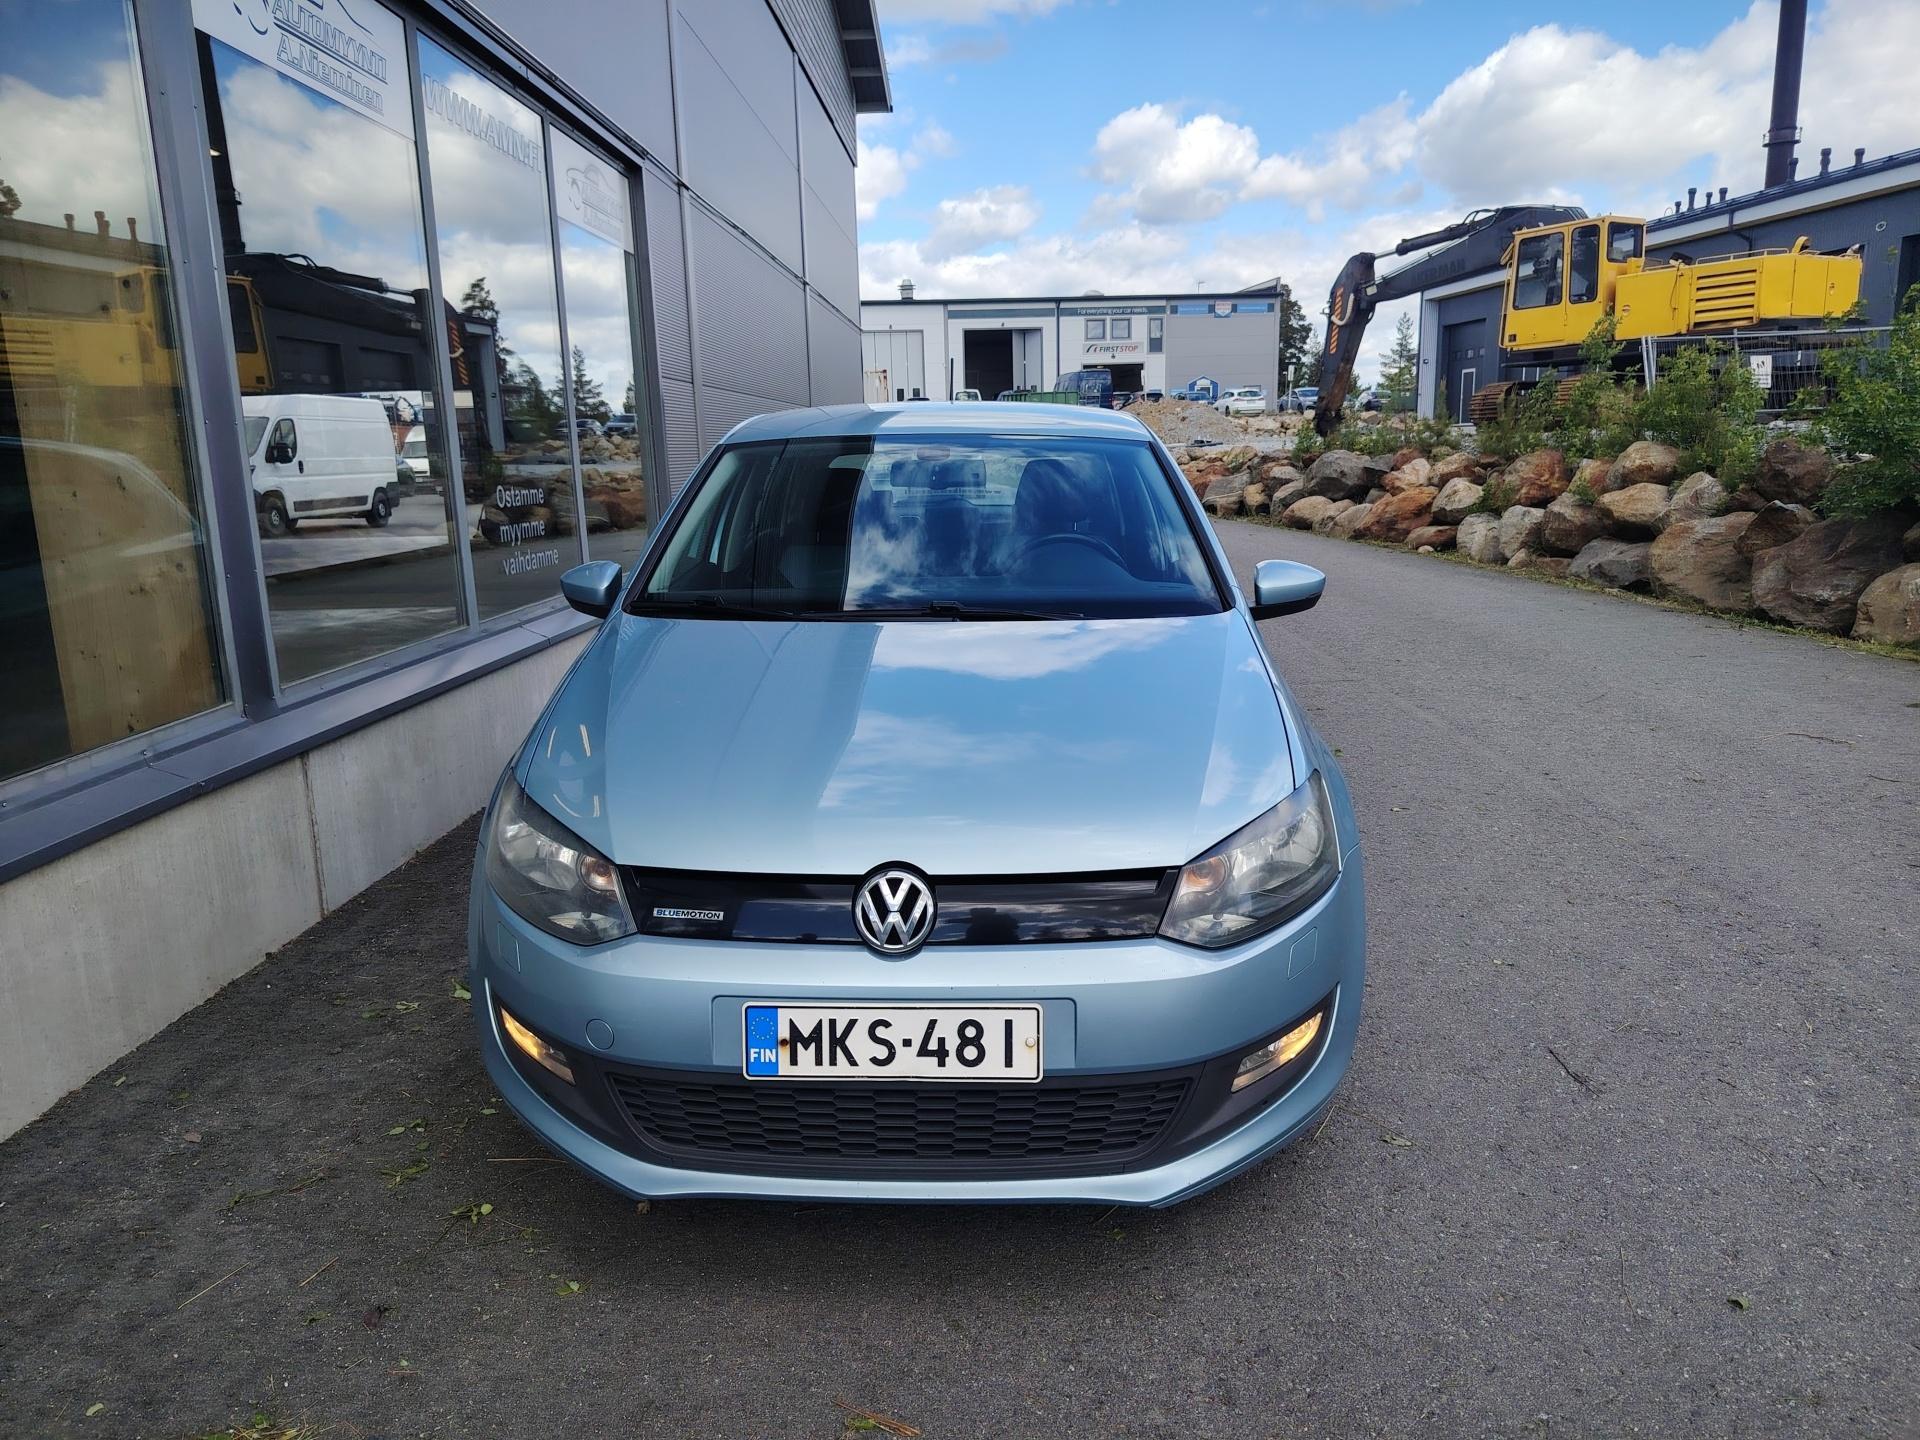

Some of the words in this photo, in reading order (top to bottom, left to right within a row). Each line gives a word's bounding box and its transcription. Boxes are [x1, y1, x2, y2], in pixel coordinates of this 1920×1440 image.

[271, 0, 388, 81] AUTOMYYNTI
[423, 73, 543, 174] WWW.AMN.FI
[496, 485, 545, 509] Ostamme
[500, 519, 546, 547] myymme
[502, 548, 560, 576] vaihdamme
[655, 908, 721, 920] BLUEMOTION
[750, 1048, 776, 1063] FIN
[789, 1018, 1013, 1069] MKS-481
